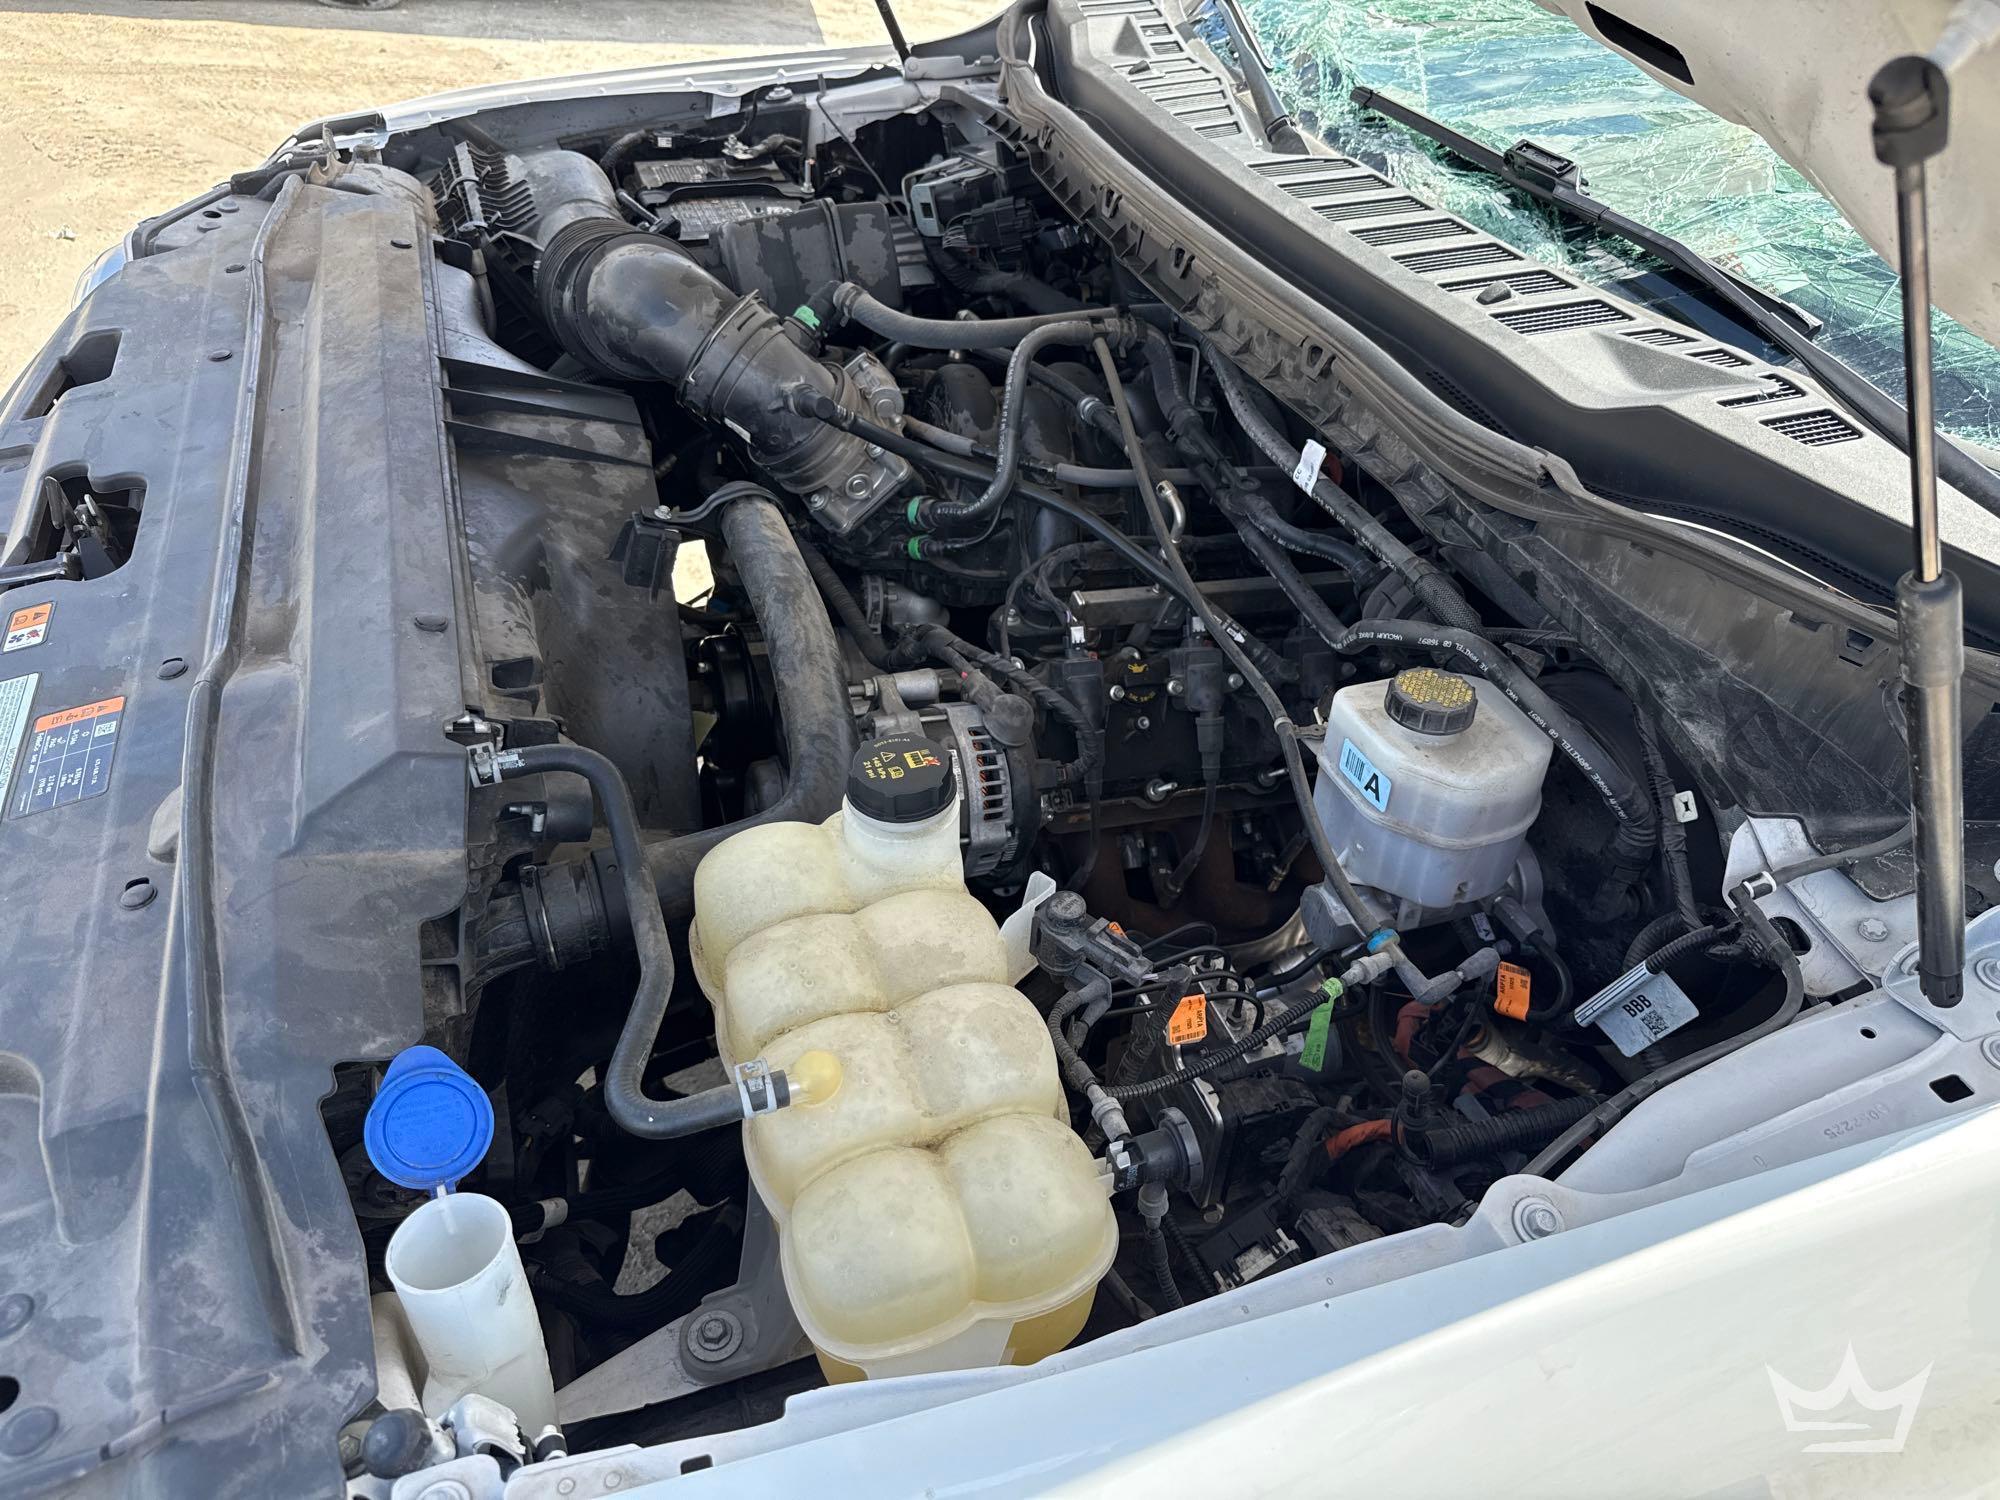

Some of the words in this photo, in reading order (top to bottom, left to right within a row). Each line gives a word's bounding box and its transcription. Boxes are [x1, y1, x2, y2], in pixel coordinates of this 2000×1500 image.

[1560, 738, 1592, 771] ARNITEL
[1364, 772, 1380, 802] A
[1622, 994, 1652, 1018] BBB
